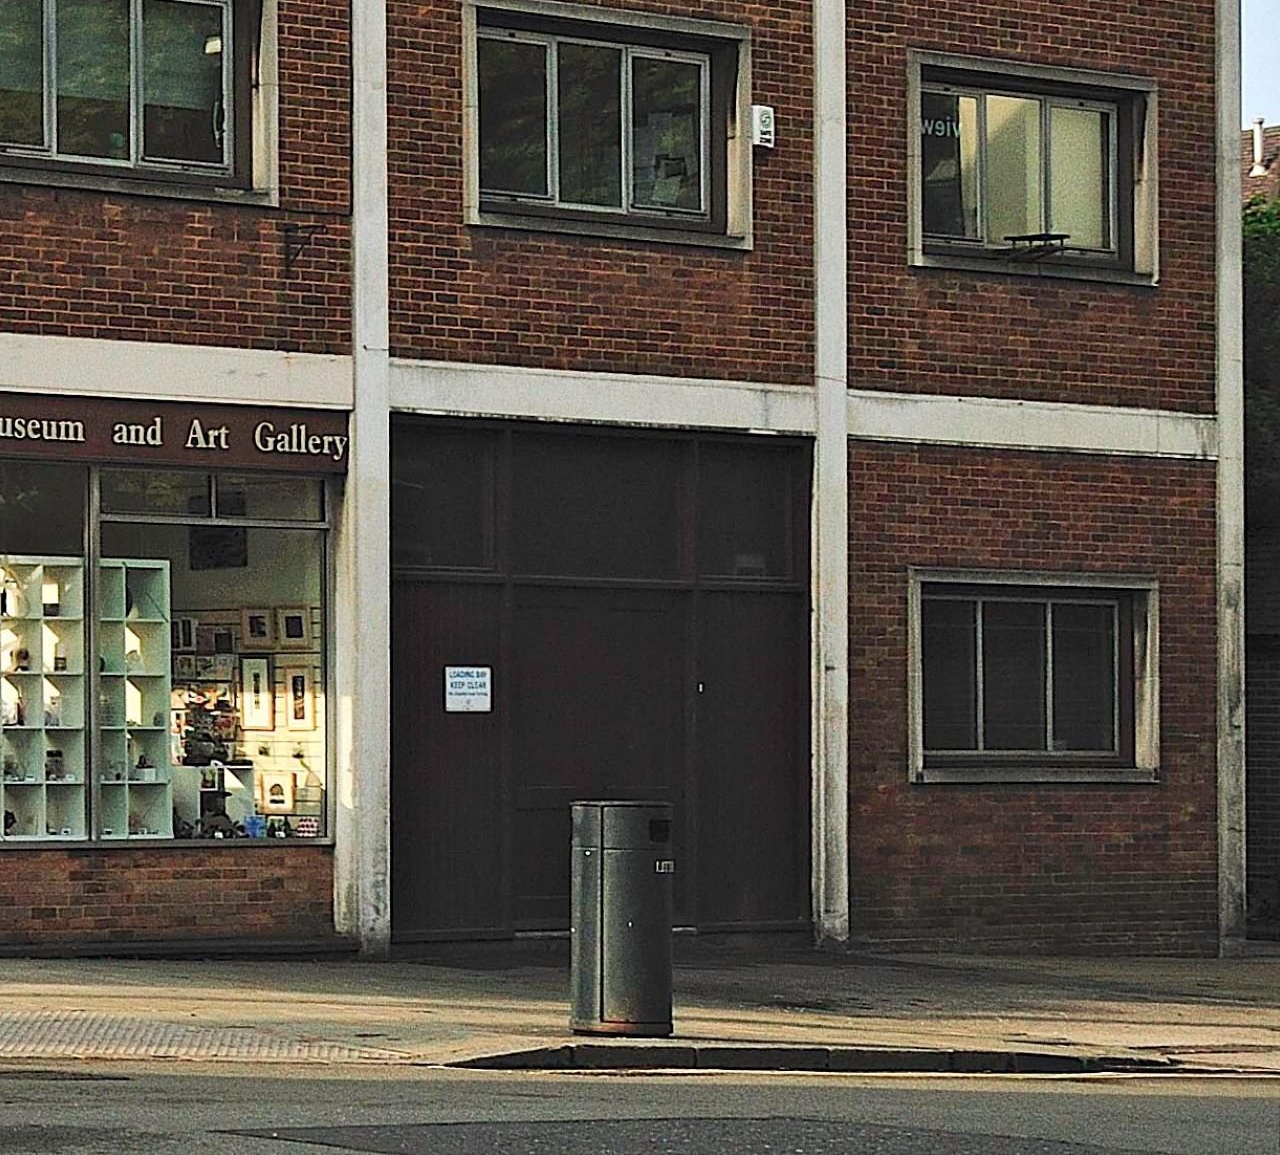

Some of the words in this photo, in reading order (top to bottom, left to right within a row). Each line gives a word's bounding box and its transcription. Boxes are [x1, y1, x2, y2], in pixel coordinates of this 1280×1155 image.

[113, 417, 163, 446] and
[185, 419, 229, 450] Art
[255, 421, 347, 461] Gallery
[467, 681, 486, 689] CLEAR
